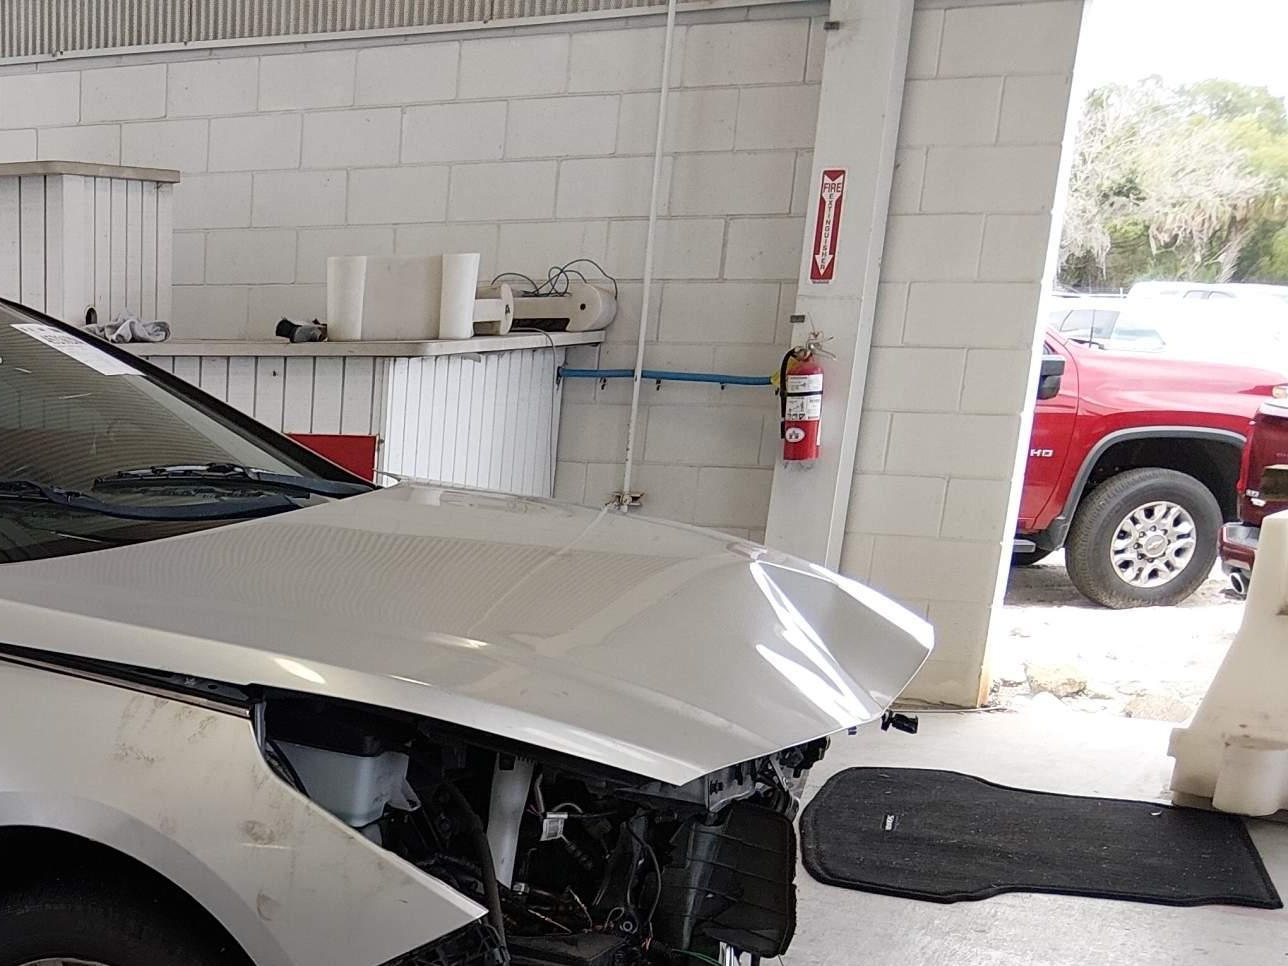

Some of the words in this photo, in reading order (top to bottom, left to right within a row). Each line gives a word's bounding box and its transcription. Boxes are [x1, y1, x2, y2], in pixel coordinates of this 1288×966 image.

[823, 183, 842, 193] FIRE
[820, 193, 834, 270] EXTINGUISHER
[1030, 449, 1054, 457] HD
